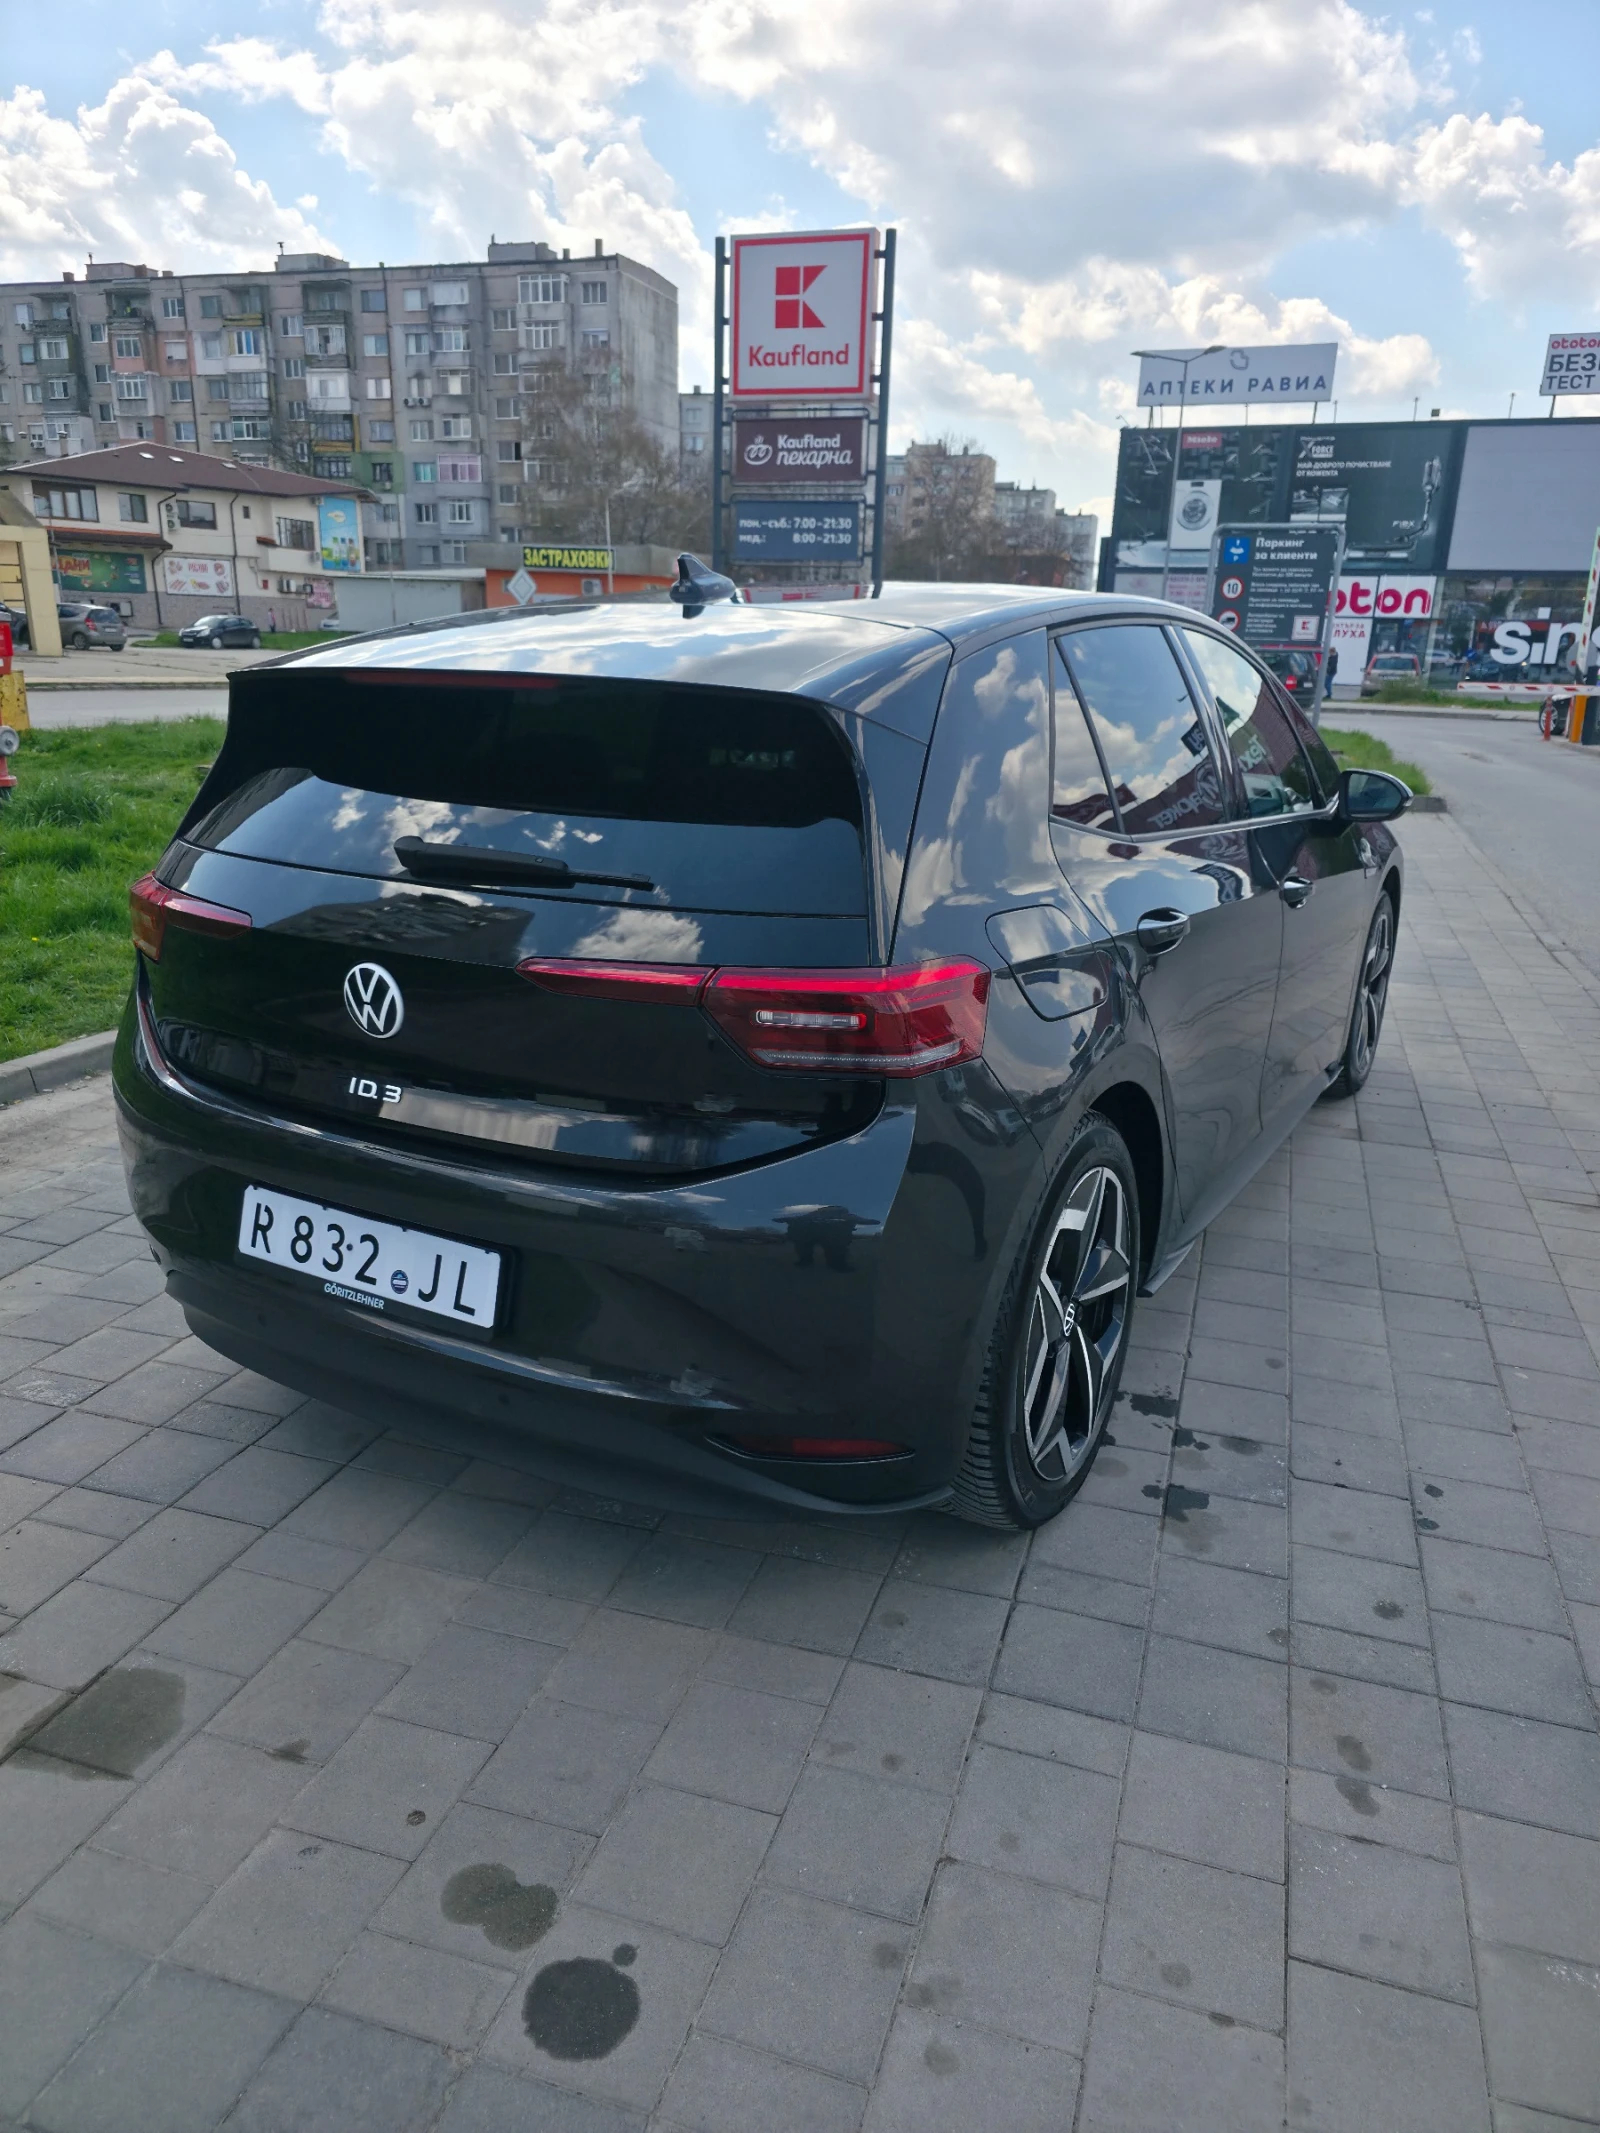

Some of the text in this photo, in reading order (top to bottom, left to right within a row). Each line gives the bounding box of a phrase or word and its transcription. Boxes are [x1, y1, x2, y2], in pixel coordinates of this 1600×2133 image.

[1551, 336, 1600, 349] ototo
[748, 343, 849, 367] Kaufland
[1548, 353, 1600, 373] БЕЗ
[1143, 375, 1327, 396] АПТЕКИ РАВИА
[1545, 374, 1596, 390] ТЕСТ
[777, 433, 841, 449] Kaufland
[776, 449, 854, 469] пекарна
[1256, 537, 1304, 549] Паркинг
[524, 548, 613, 569] ЗАСТРАХОВКИ
[1254, 551, 1318, 560] за клиенти
[1227, 583, 1239, 595] 10
[1328, 581, 1432, 615] oton
[1333, 629, 1366, 638] ЛУХА
[250, 1202, 476, 1317] R 832 JL
[324, 1282, 384, 1311] GÖRITZLEHNER
